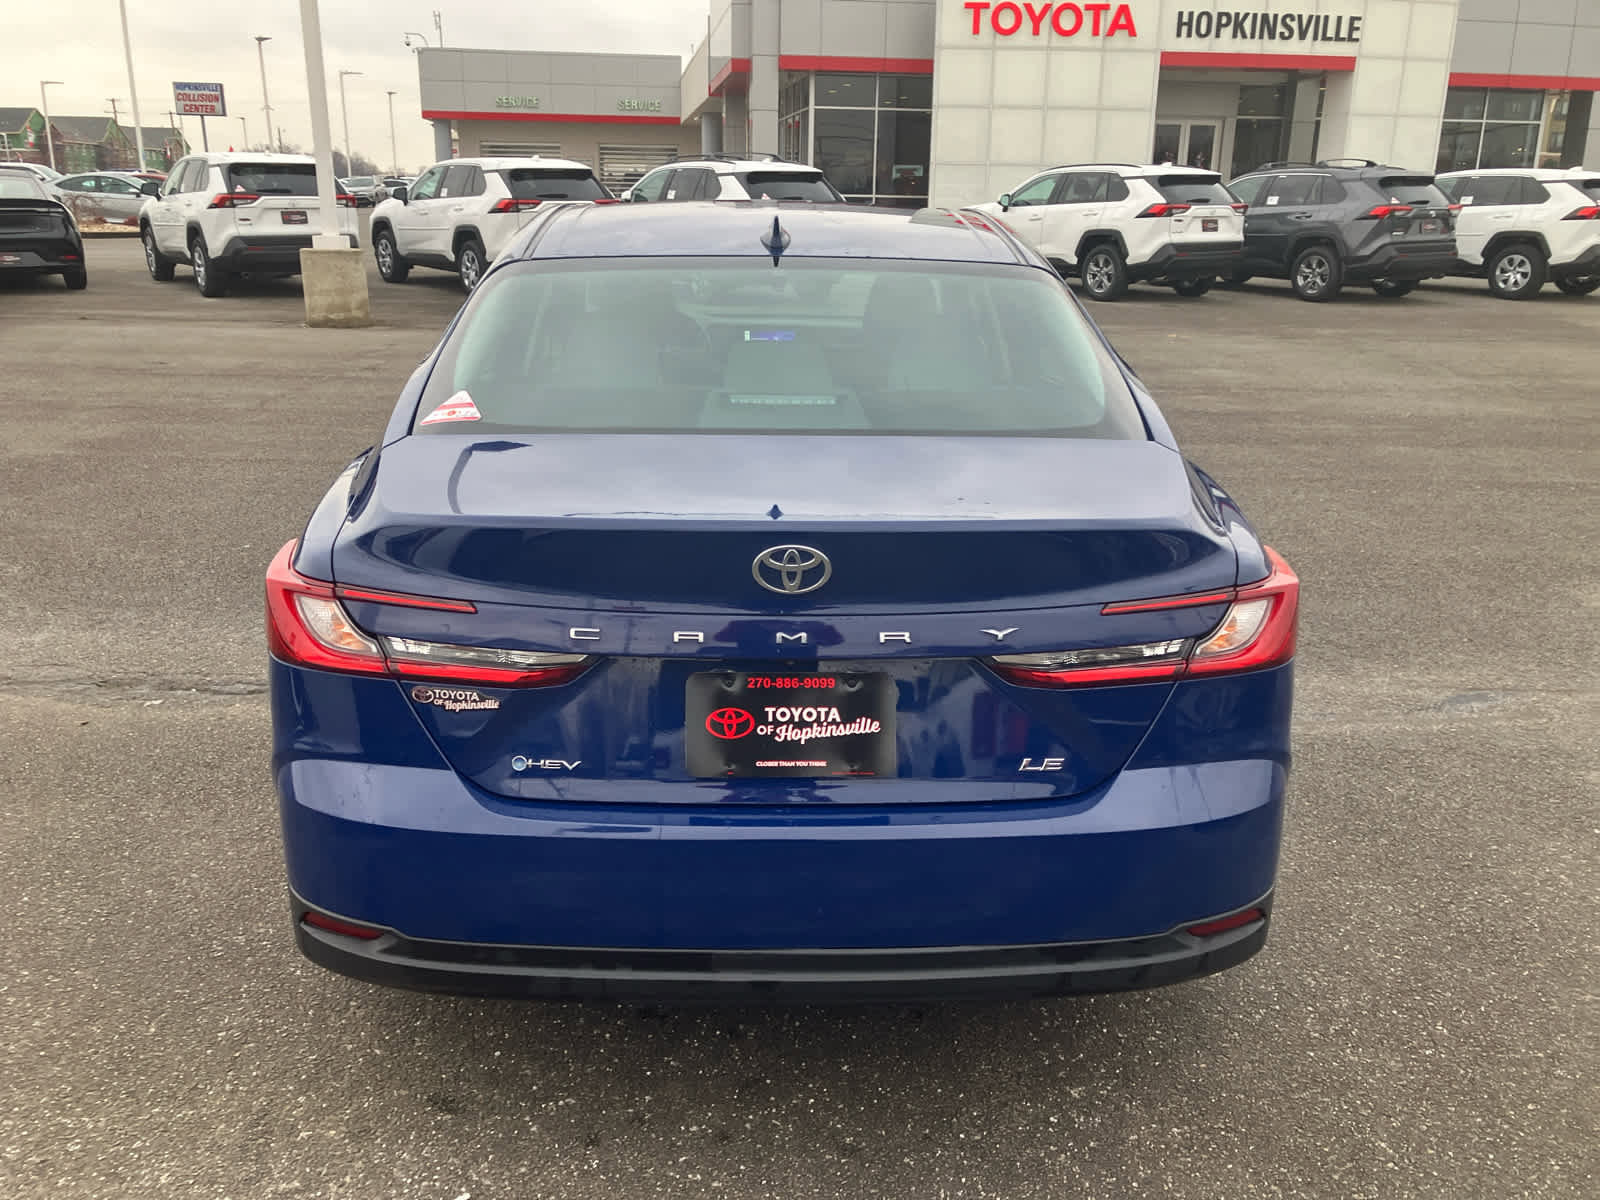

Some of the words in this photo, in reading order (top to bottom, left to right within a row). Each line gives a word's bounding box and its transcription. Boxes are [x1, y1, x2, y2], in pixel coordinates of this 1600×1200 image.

[964, 2, 1137, 37] TOYOTA
[1176, 11, 1362, 42] HOPKINSVILLE
[176, 92, 219, 103] COLLISION
[496, 96, 539, 109] SERVICE
[183, 103, 216, 113] CENTER
[617, 99, 662, 112] SERVICE
[569, 627, 1019, 645] CAMRY
[747, 677, 836, 688] 270-886-9099
[434, 689, 480, 700] TOYOTA
[445, 700, 500, 712] Hopkinsville
[764, 706, 841, 722] TOYOTA
[756, 725, 774, 735] OF
[774, 716, 881, 744] Hopkinsville
[1018, 757, 1065, 772] LE
